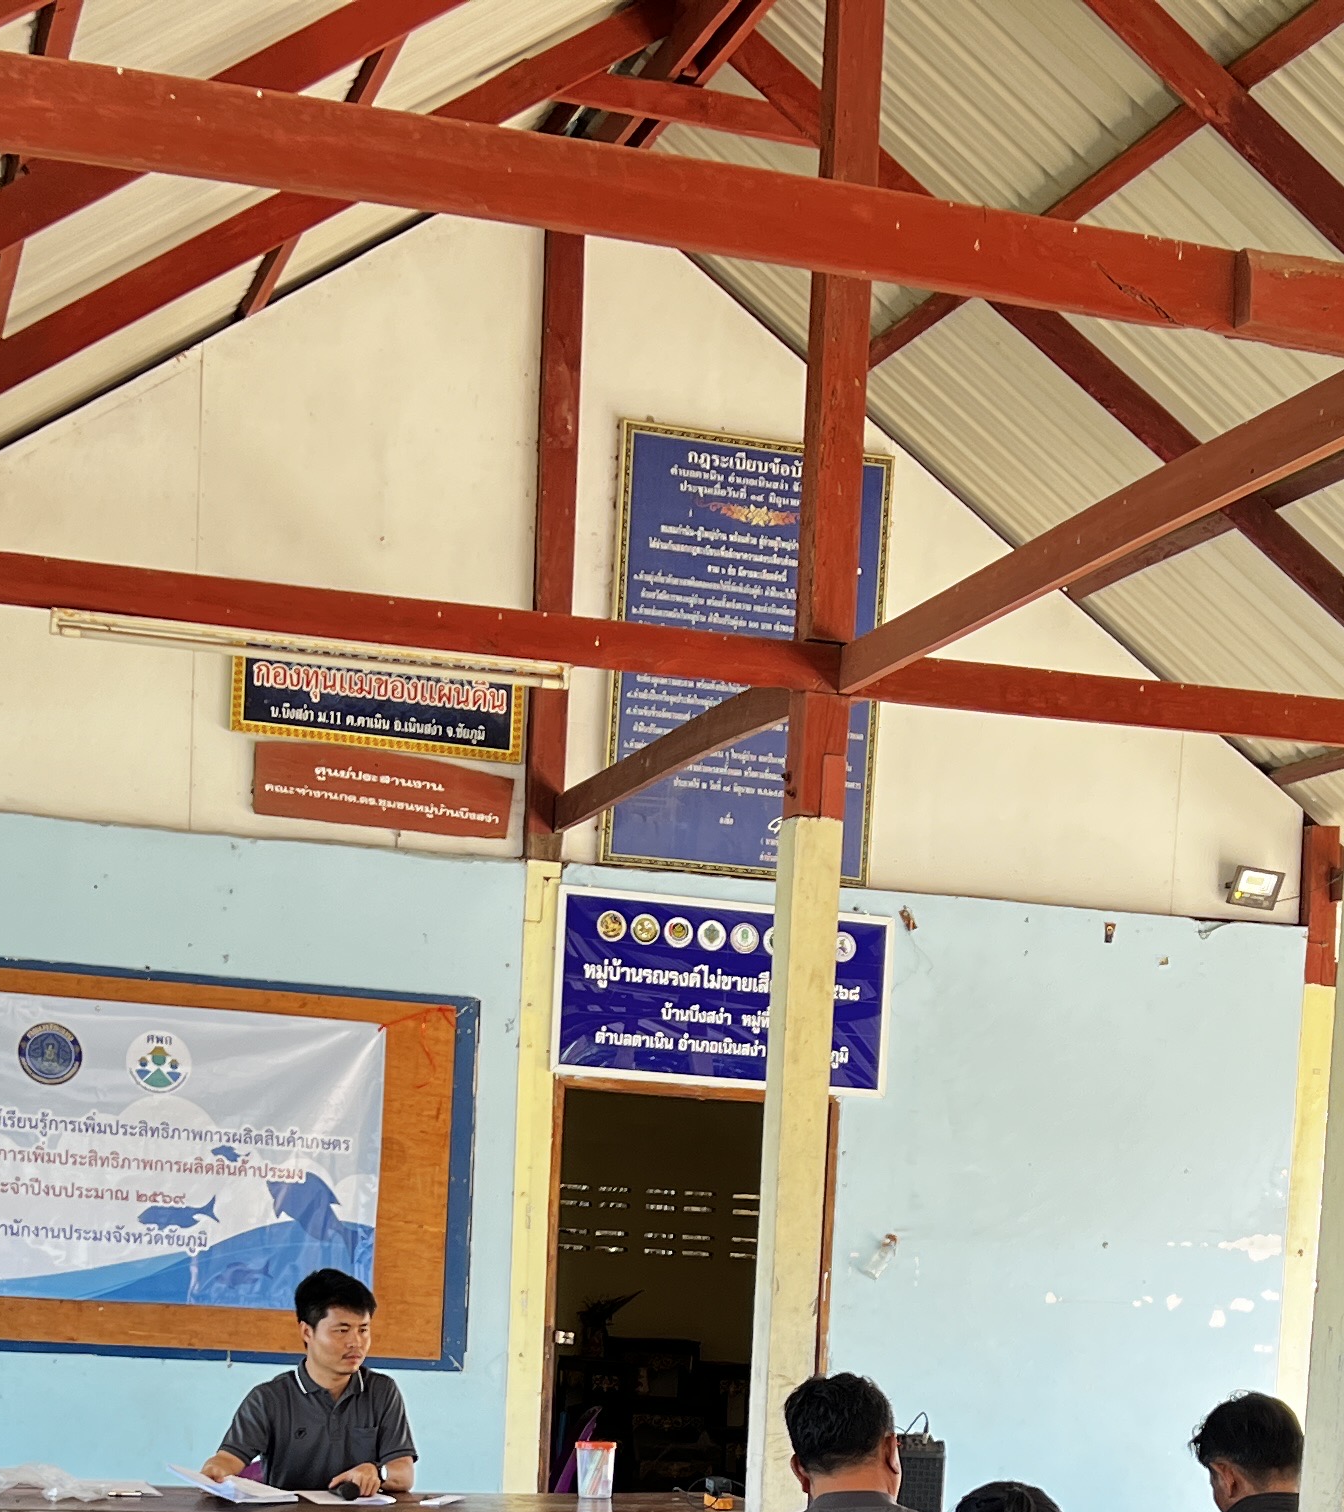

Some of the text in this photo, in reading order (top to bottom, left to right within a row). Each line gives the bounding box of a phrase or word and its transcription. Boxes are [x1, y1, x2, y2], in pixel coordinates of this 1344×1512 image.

[317, 711, 341, 726] ม.11
[583, 958, 771, 994] หมู่บ้านรณรงค์ไม่ขายเสี
[661, 1002, 732, 1025] บ้านบึงสง่า
[595, 1025, 673, 1050] ตำบลตาเนิน
[678, 1033, 767, 1057] อำเภอเนินสง่า
